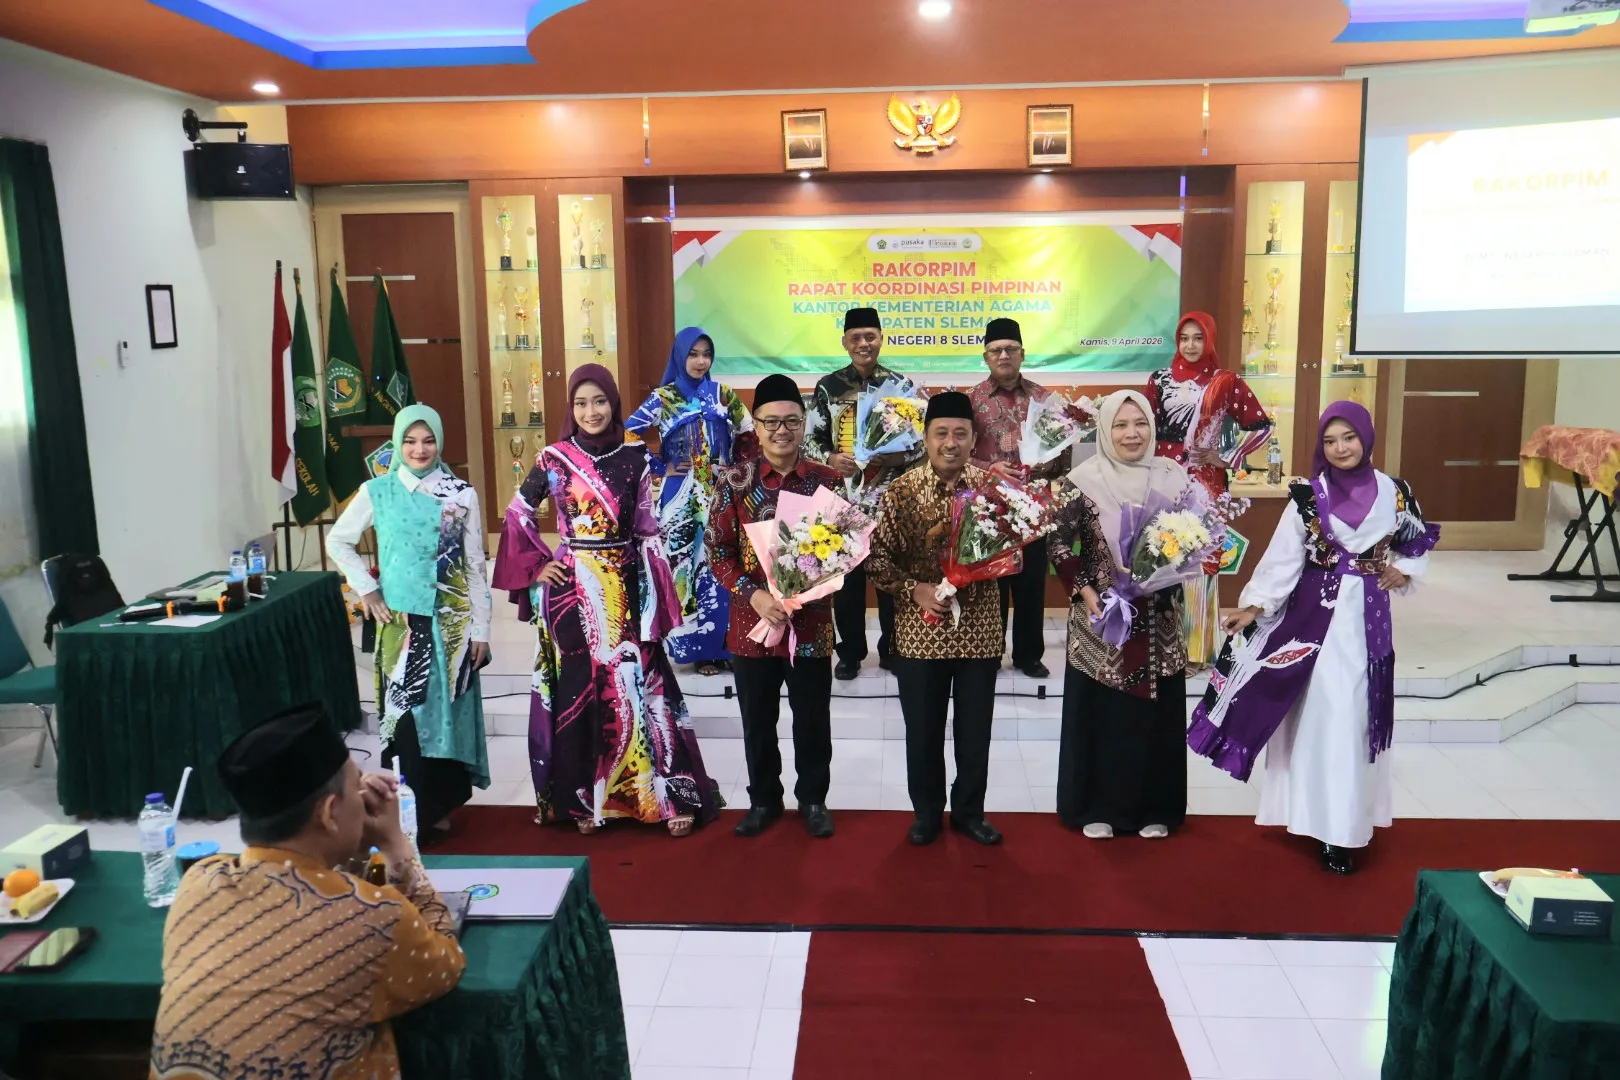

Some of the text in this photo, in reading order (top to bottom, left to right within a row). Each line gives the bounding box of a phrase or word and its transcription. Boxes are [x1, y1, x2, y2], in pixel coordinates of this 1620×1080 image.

[872, 261, 976, 277] RAKORPIM
[788, 281, 1061, 296] RAPAT KOORDINASI PIMPINAN
[990, 300, 1052, 312] AGAMA
[836, 317, 935, 329] KPATEN
[887, 335, 936, 346] NEGERI
[940, 335, 948, 345] 8
[1080, 338, 1110, 346] Kamis,
[1119, 337, 1140, 347] April
[1141, 337, 1163, 345] 2026
